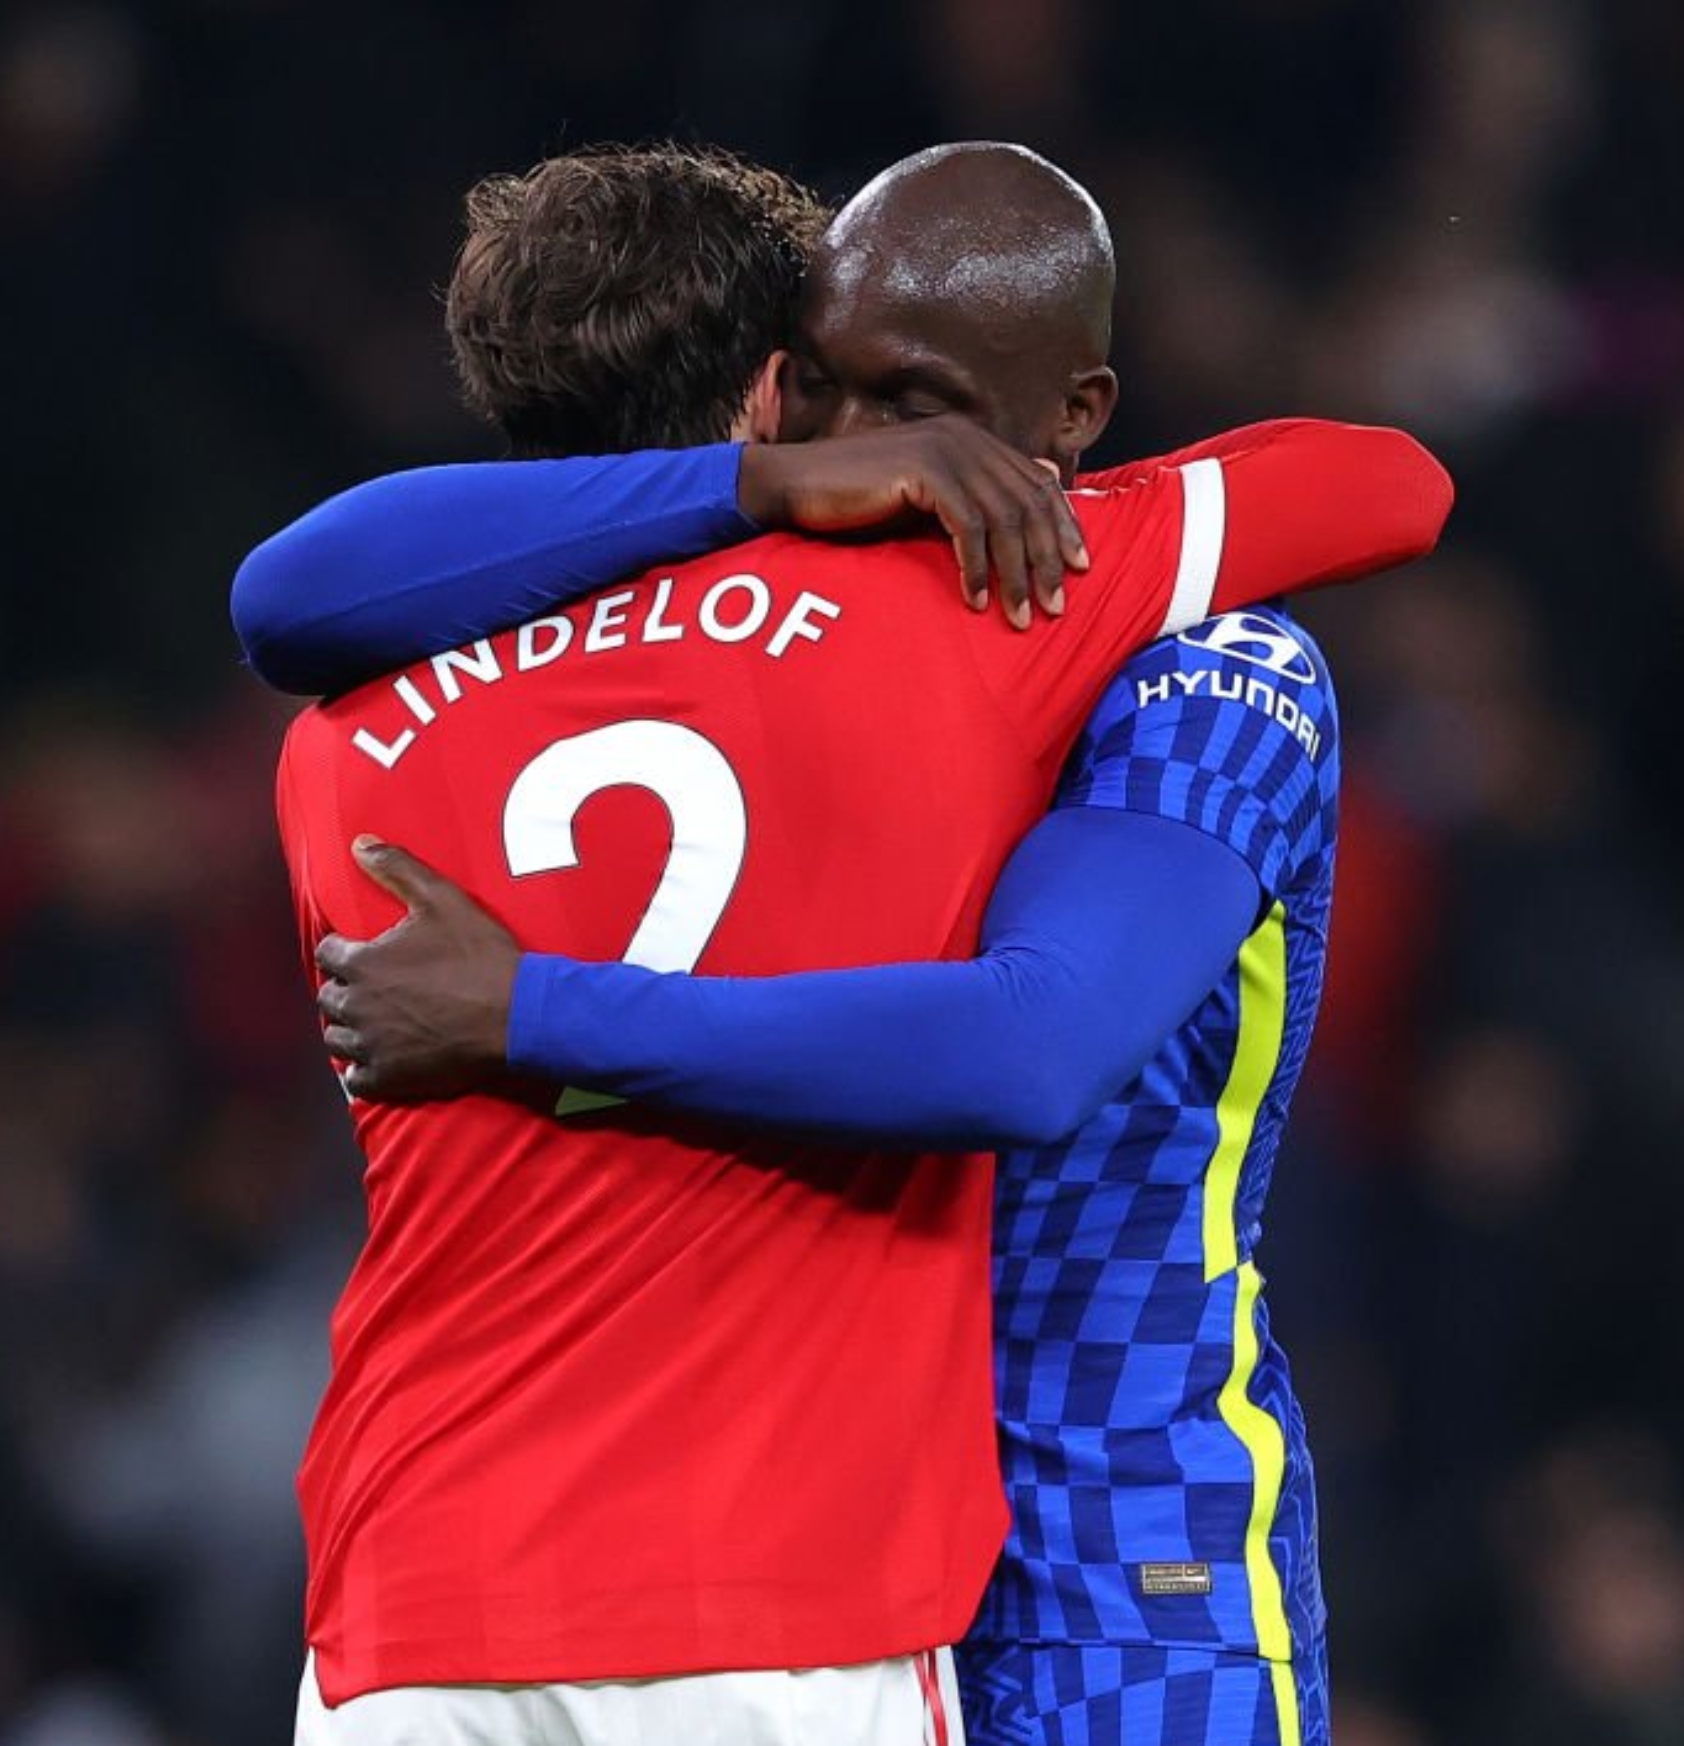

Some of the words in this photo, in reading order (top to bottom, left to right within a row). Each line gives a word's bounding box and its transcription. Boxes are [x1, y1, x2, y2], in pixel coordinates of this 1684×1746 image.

[352, 573, 841, 770] LINDELOF
[1138, 670, 1321, 763] HYUNDAI
[502, 718, 748, 1115] 2
